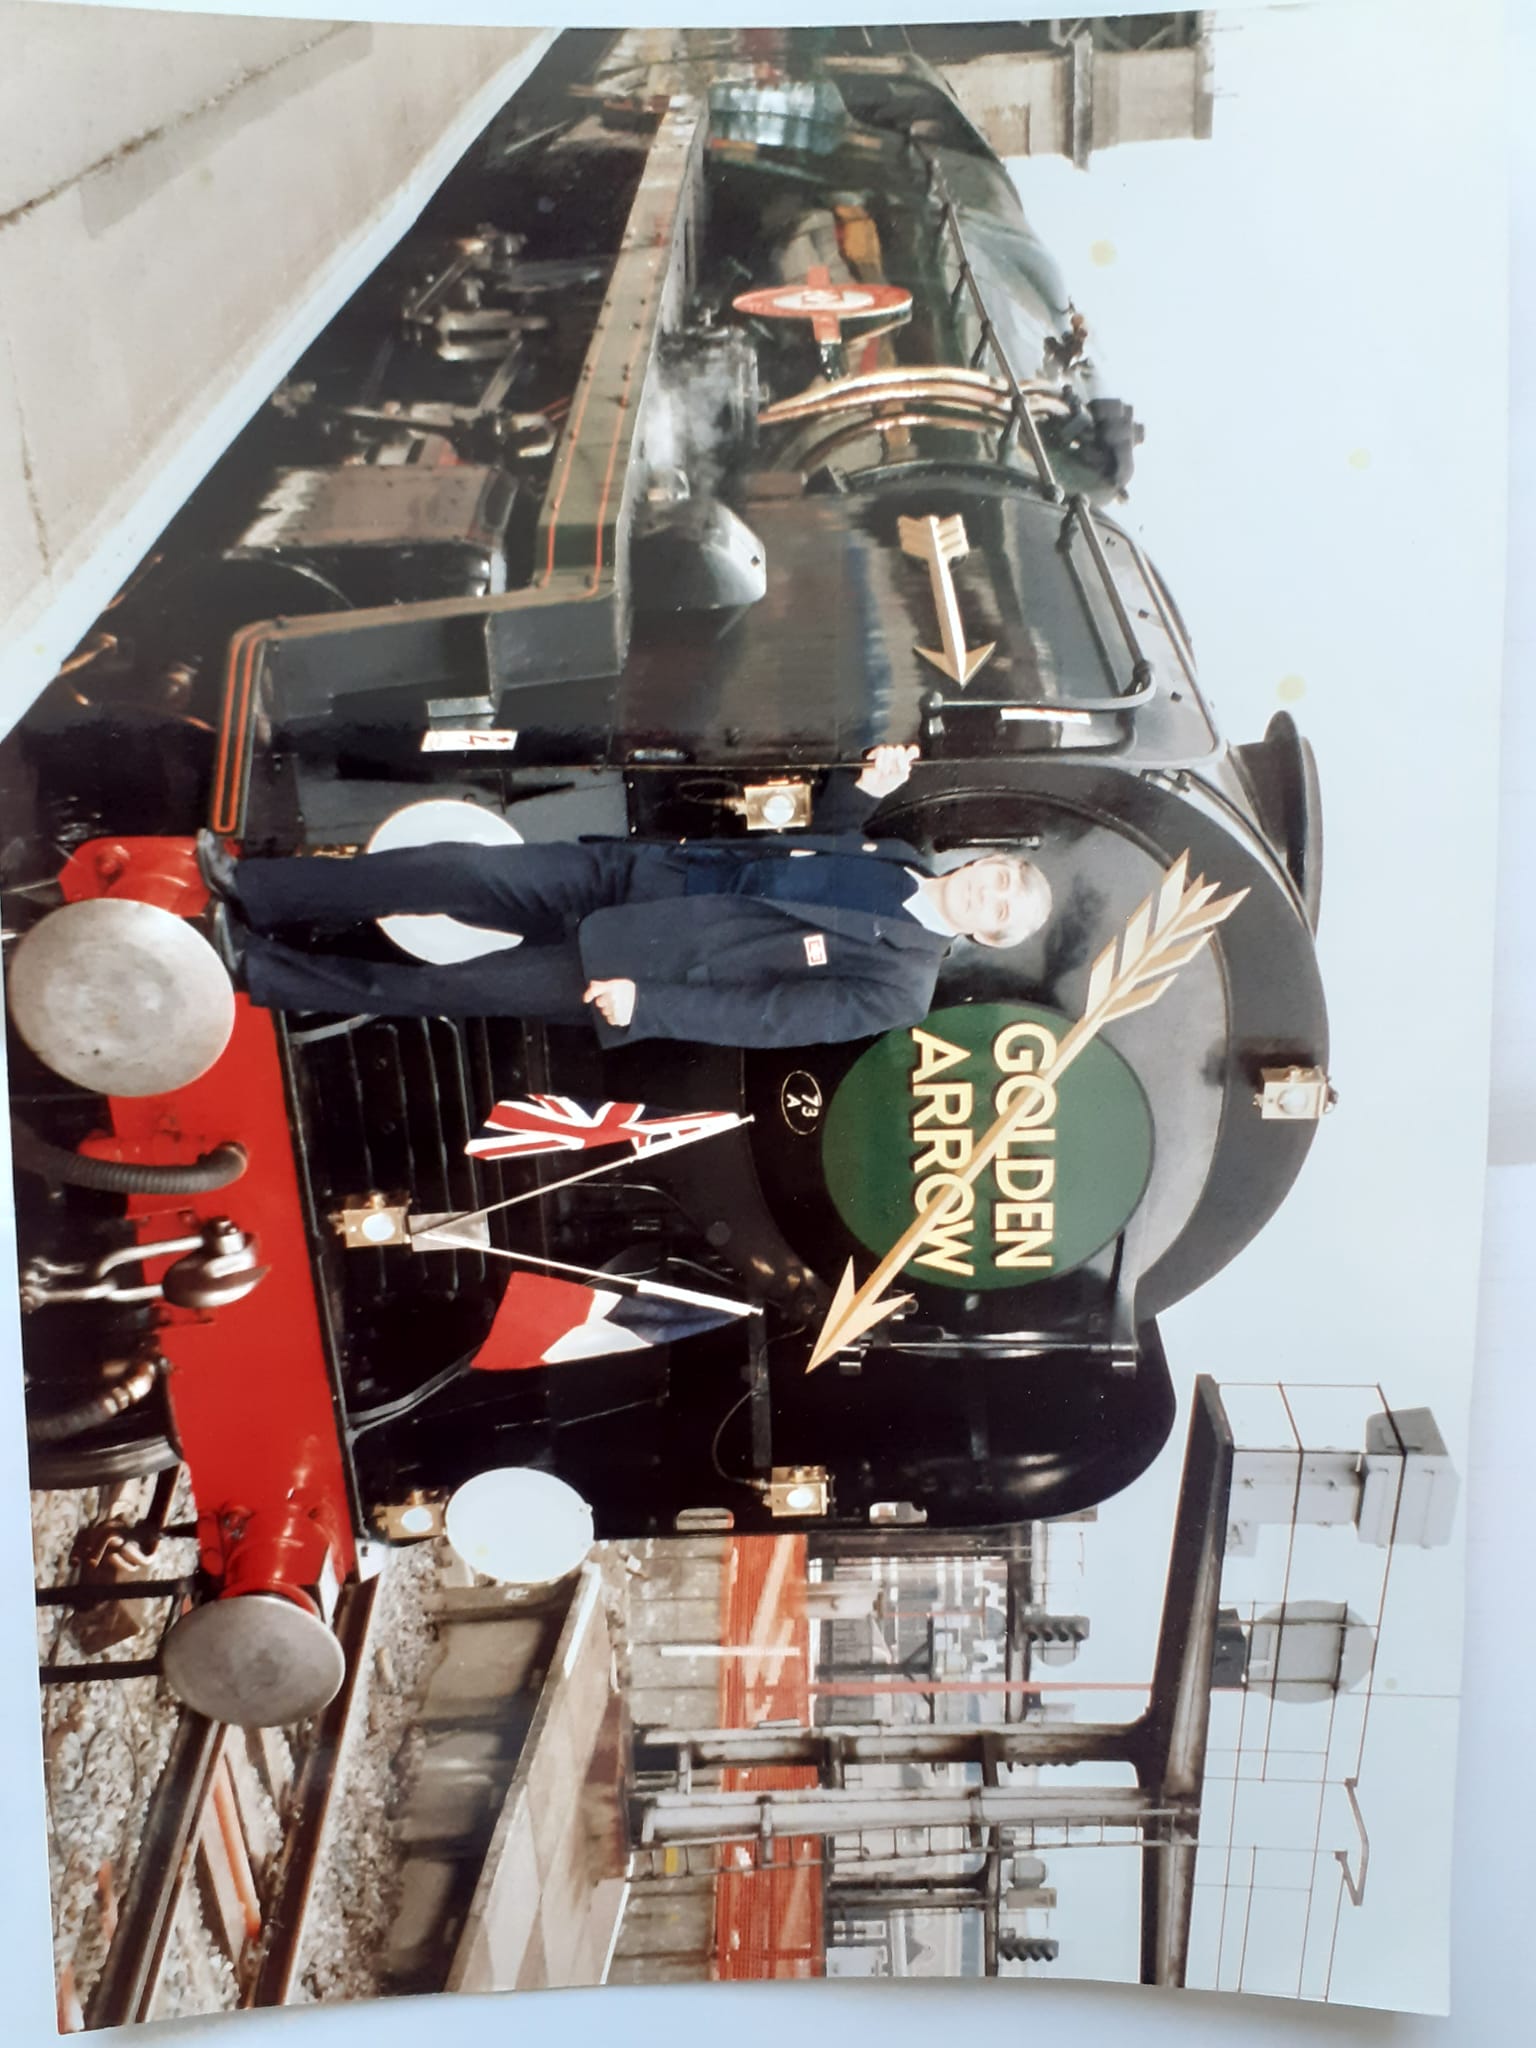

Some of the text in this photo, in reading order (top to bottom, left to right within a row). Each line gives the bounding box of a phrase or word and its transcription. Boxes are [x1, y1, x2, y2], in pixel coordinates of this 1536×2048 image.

[787, 1094, 802, 1107] A
[801, 1094, 821, 1118] 73
[912, 1028, 975, 1276] ARROW
[993, 1023, 1057, 1267] GOLDEN
